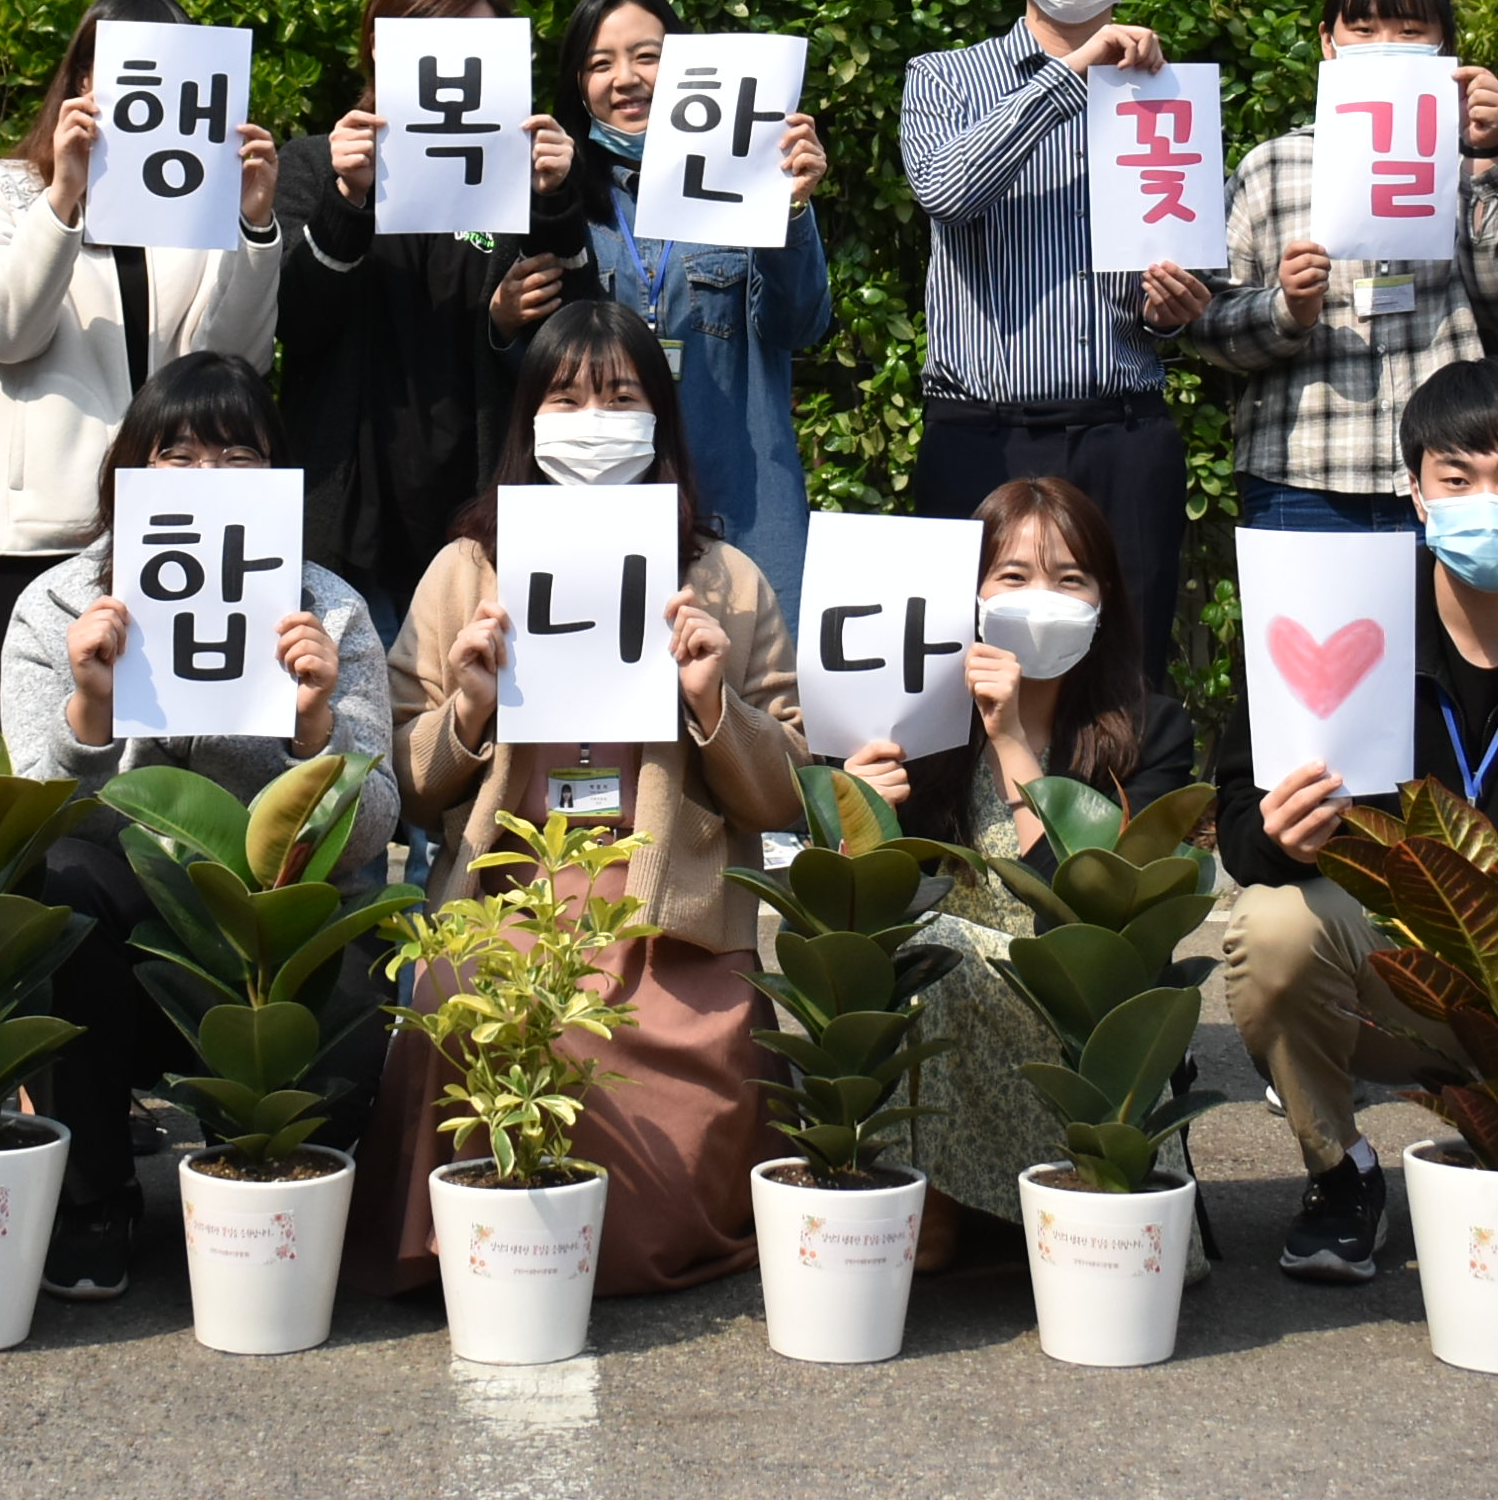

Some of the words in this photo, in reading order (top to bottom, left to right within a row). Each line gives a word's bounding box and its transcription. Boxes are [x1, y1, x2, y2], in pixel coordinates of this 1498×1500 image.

[112, 60, 229, 199] 행
[405, 56, 501, 186] 복
[669, 67, 787, 204] 한
[1116, 99, 1204, 225] 꽃
[1335, 92, 1439, 218] 길
[139, 513, 284, 682] 합
[527, 553, 648, 664] 니
[819, 596, 964, 695] 다
